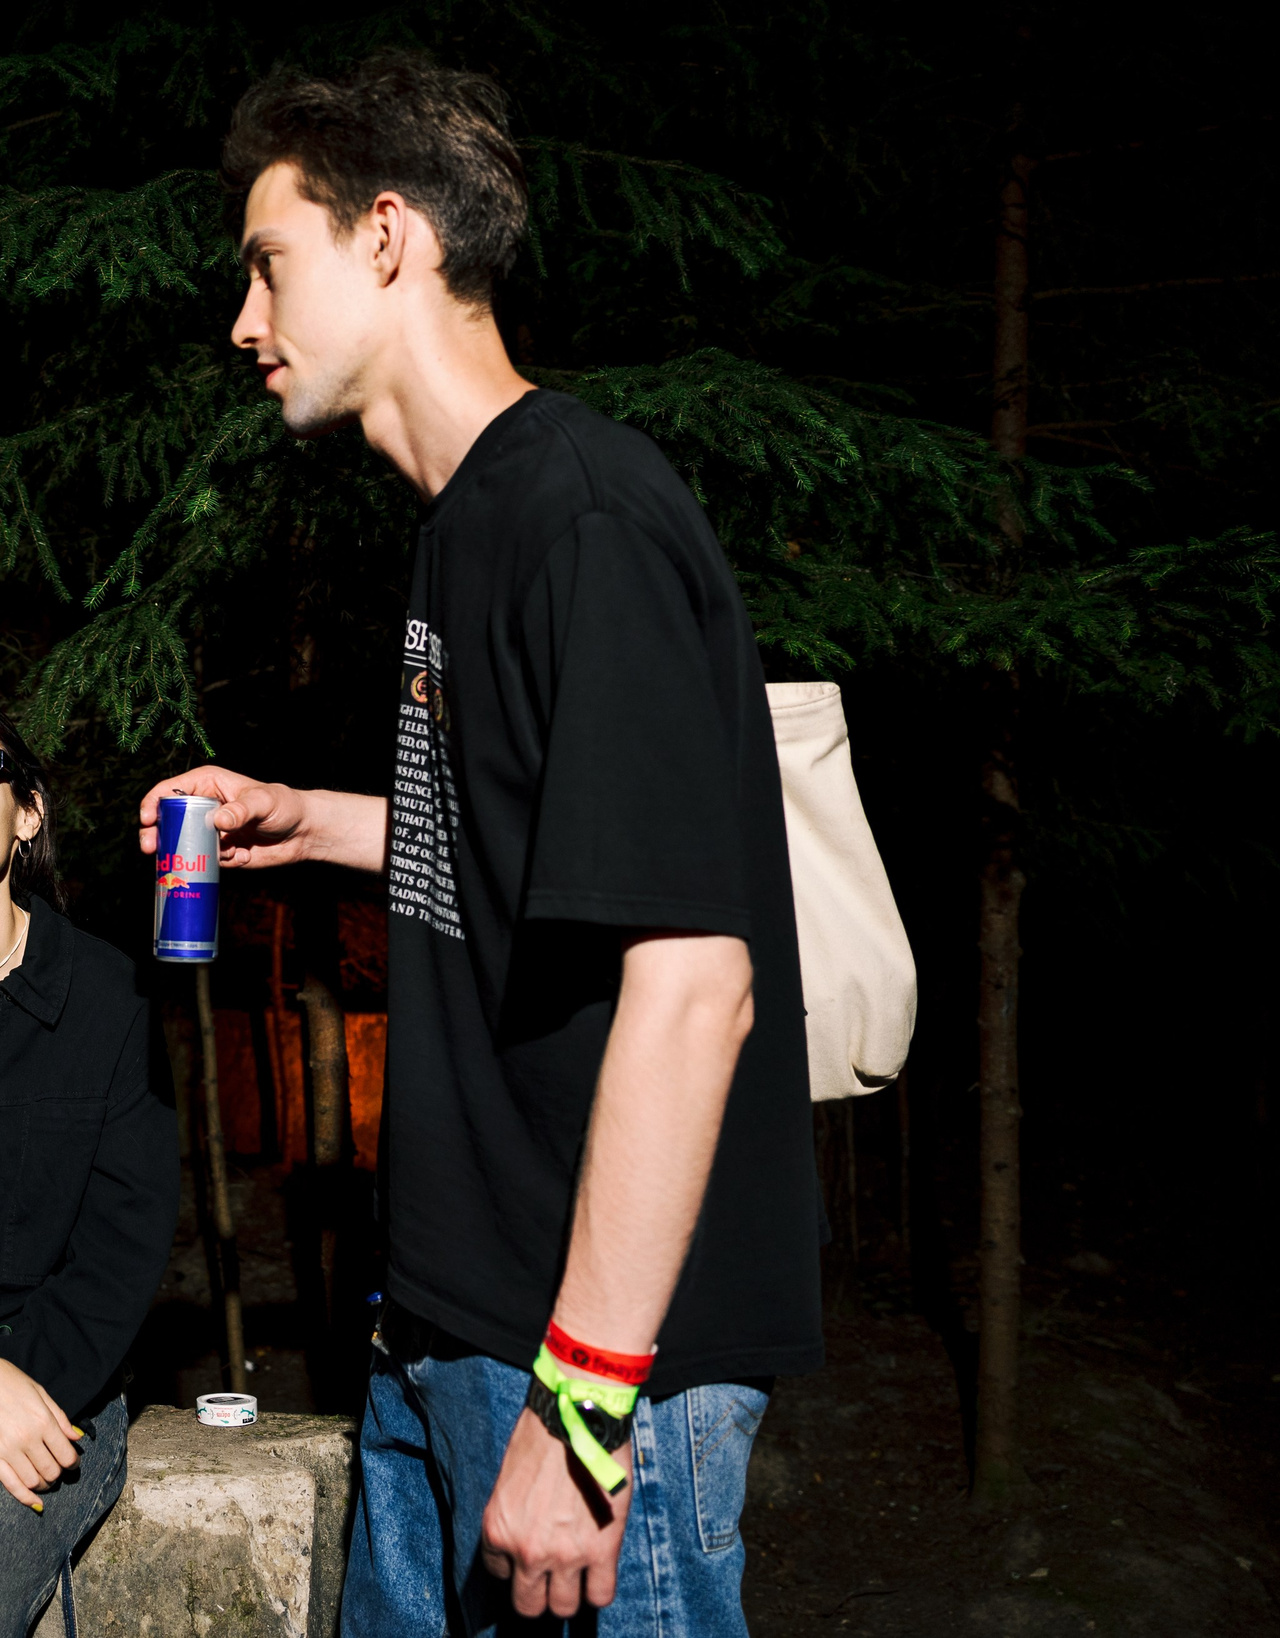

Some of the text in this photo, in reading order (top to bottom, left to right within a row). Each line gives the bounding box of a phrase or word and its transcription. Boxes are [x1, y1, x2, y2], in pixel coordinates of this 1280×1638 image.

[172, 854, 206, 872] Bull
[173, 890, 201, 899] DRINK
[389, 902, 415, 917] AND
